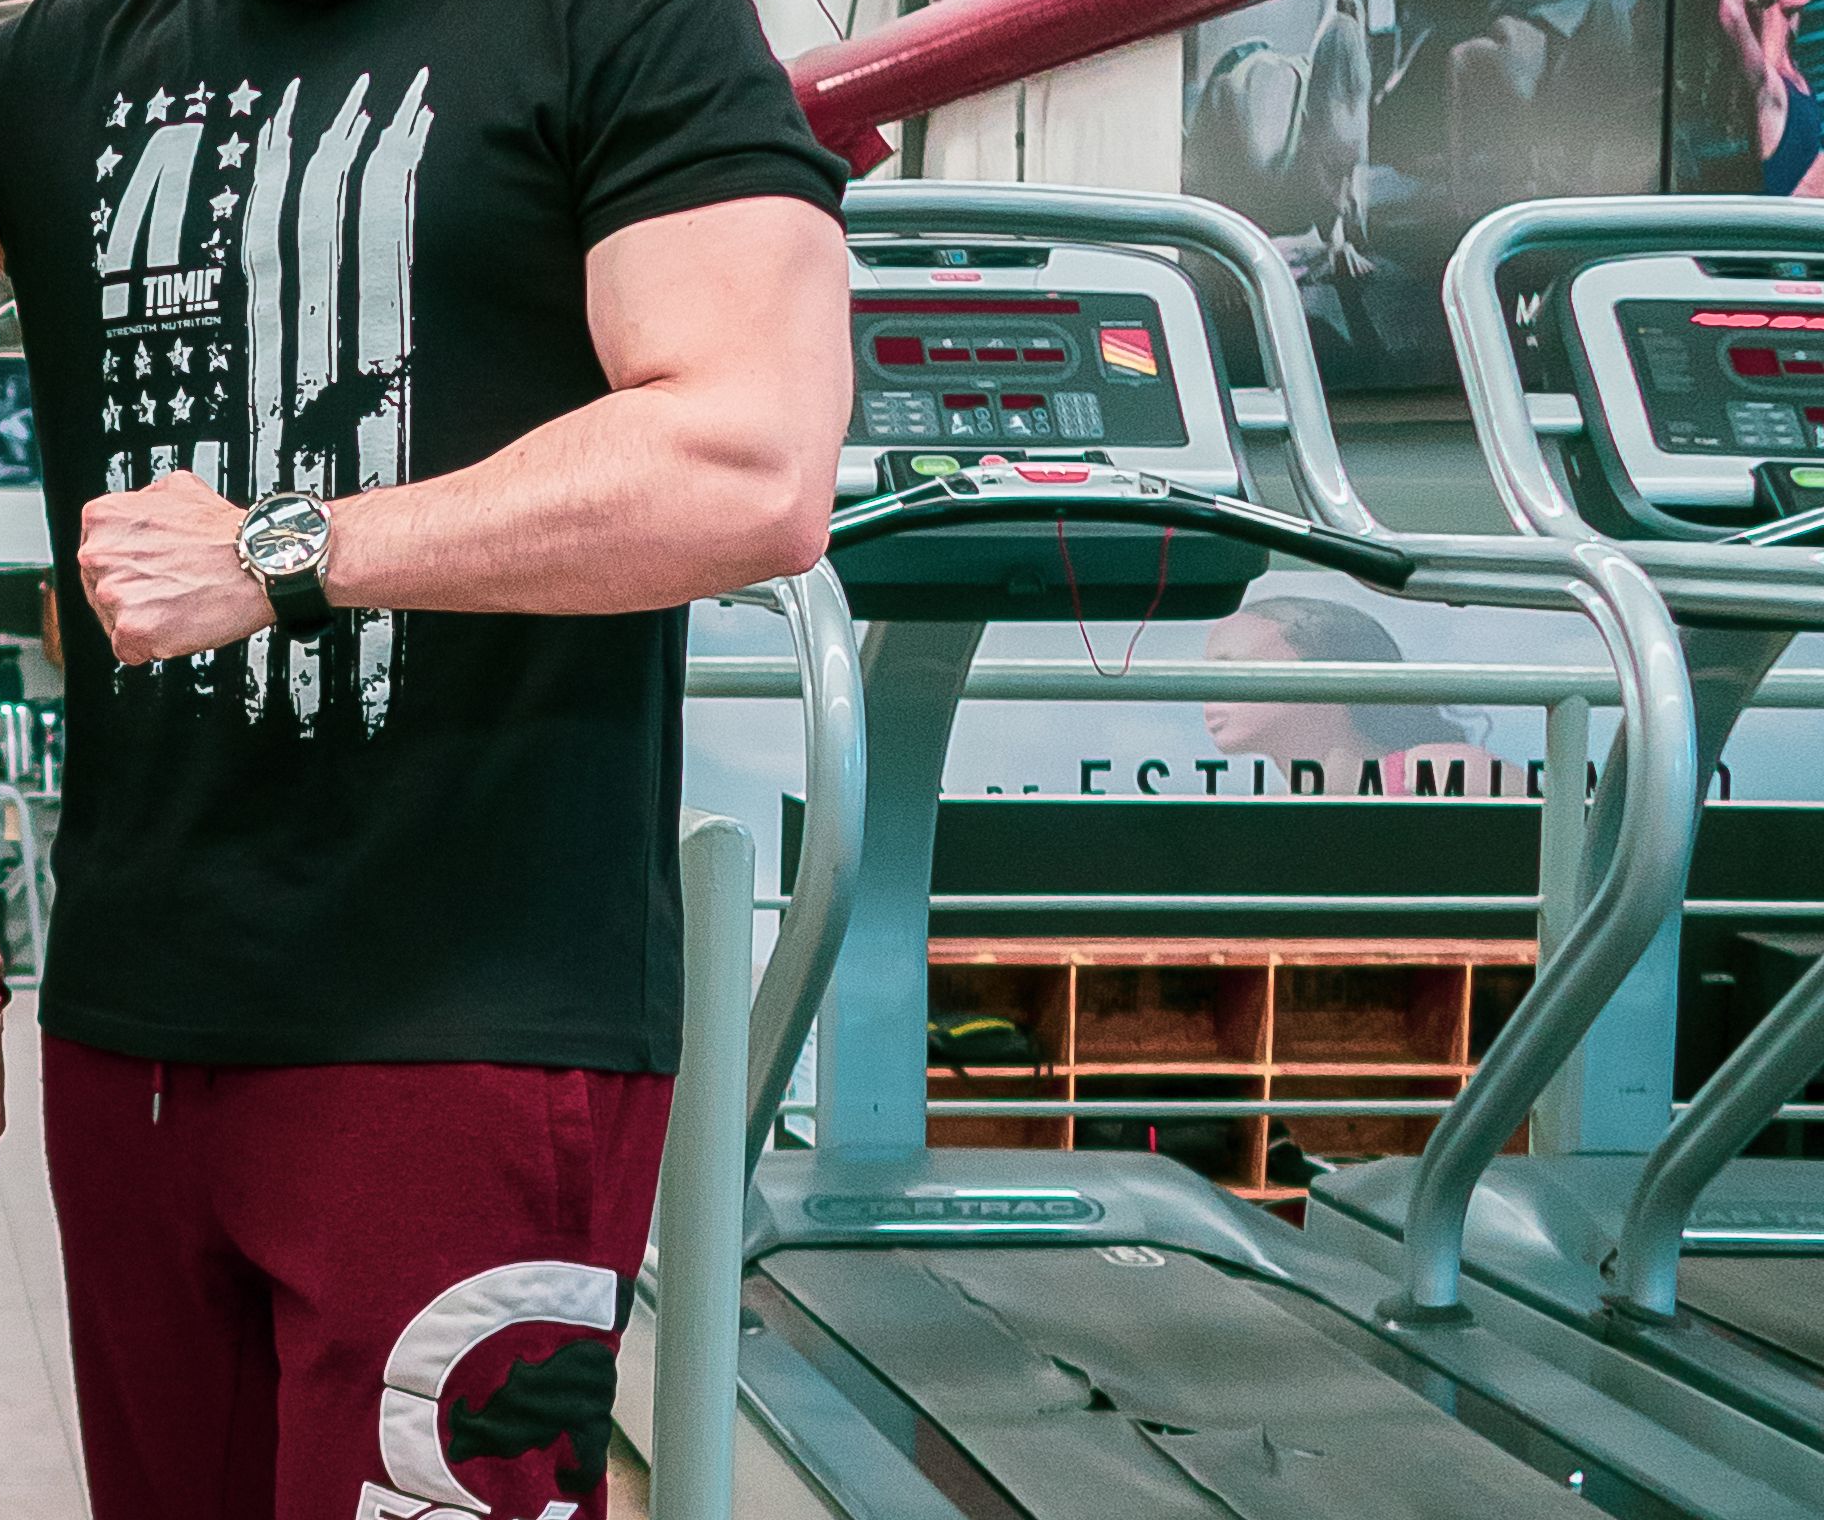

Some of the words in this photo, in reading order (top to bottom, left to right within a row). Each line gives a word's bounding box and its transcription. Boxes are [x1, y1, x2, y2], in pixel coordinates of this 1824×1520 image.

[106, 324, 157, 338] STRENGTH
[161, 316, 222, 330] NUTRITION
[952, 1201, 1076, 1217] TRAC
